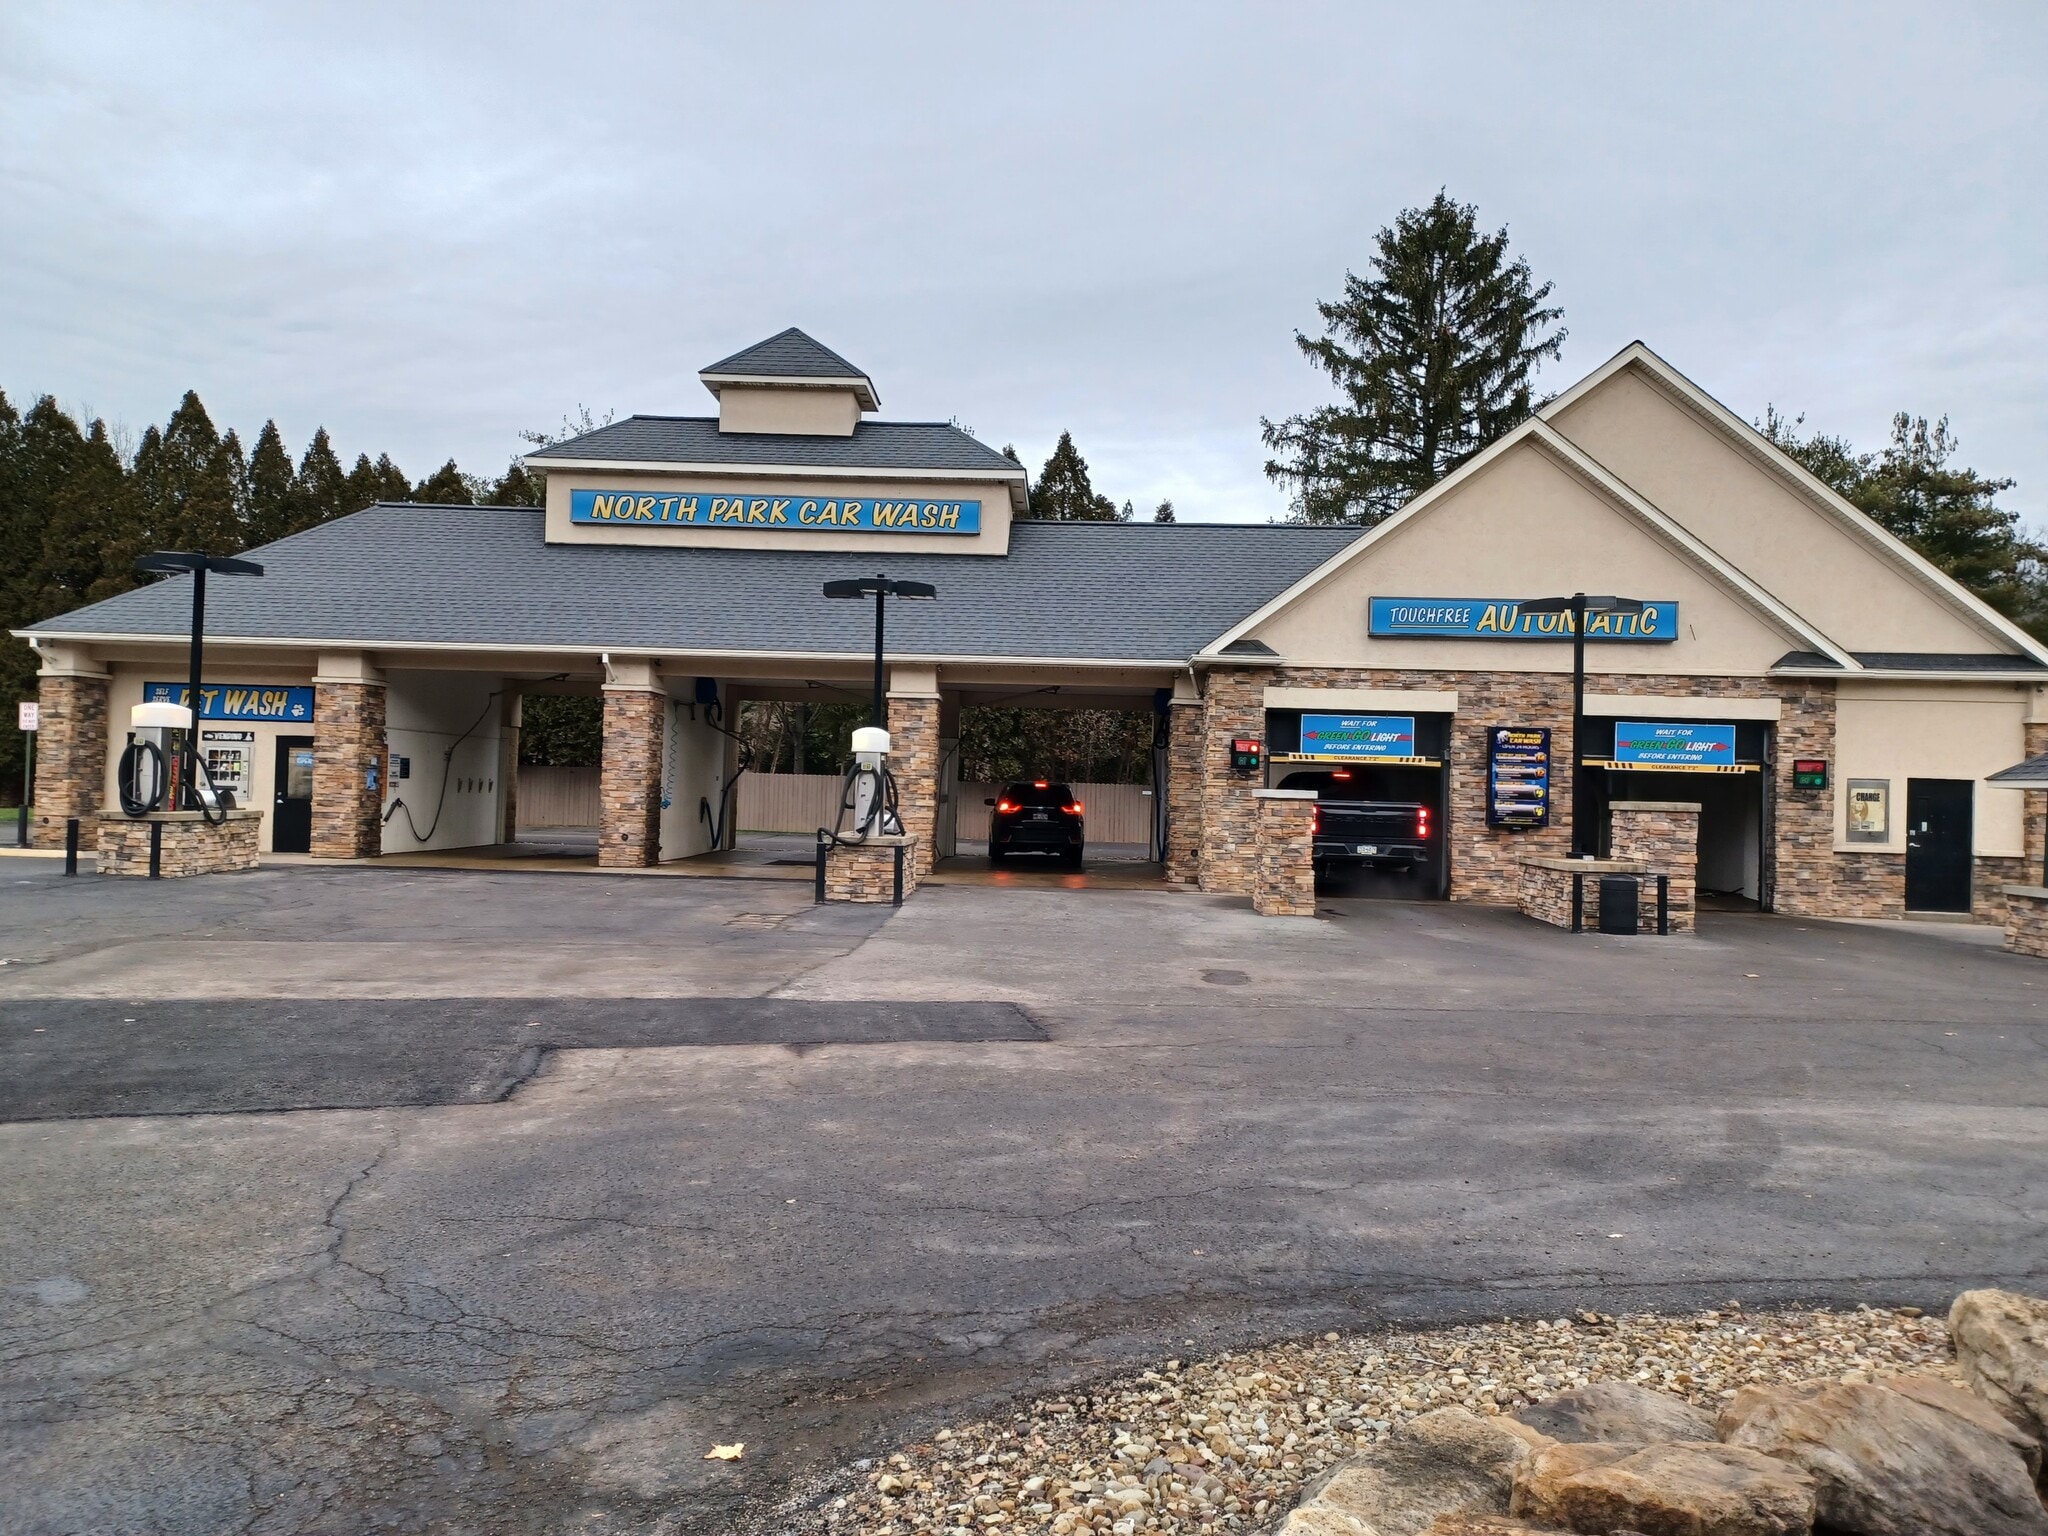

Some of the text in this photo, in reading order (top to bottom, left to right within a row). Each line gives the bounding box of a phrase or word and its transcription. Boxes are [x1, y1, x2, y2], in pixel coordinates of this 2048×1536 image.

[591, 494, 961, 530] NORTH PARK CAR WASH
[1390, 607, 1472, 624] TOUCHFREE
[155, 688, 171, 696] SELF
[223, 689, 288, 717] WASH
[1317, 729, 1401, 743] GREEN GO LIGHT
[1323, 743, 1387, 752] BEFORE ENTERING
[1630, 738, 1717, 752] GREEN GO LIGHT
[1637, 752, 1703, 761] BEFORE ENTERING
[1856, 792, 1881, 802] CHANGE
